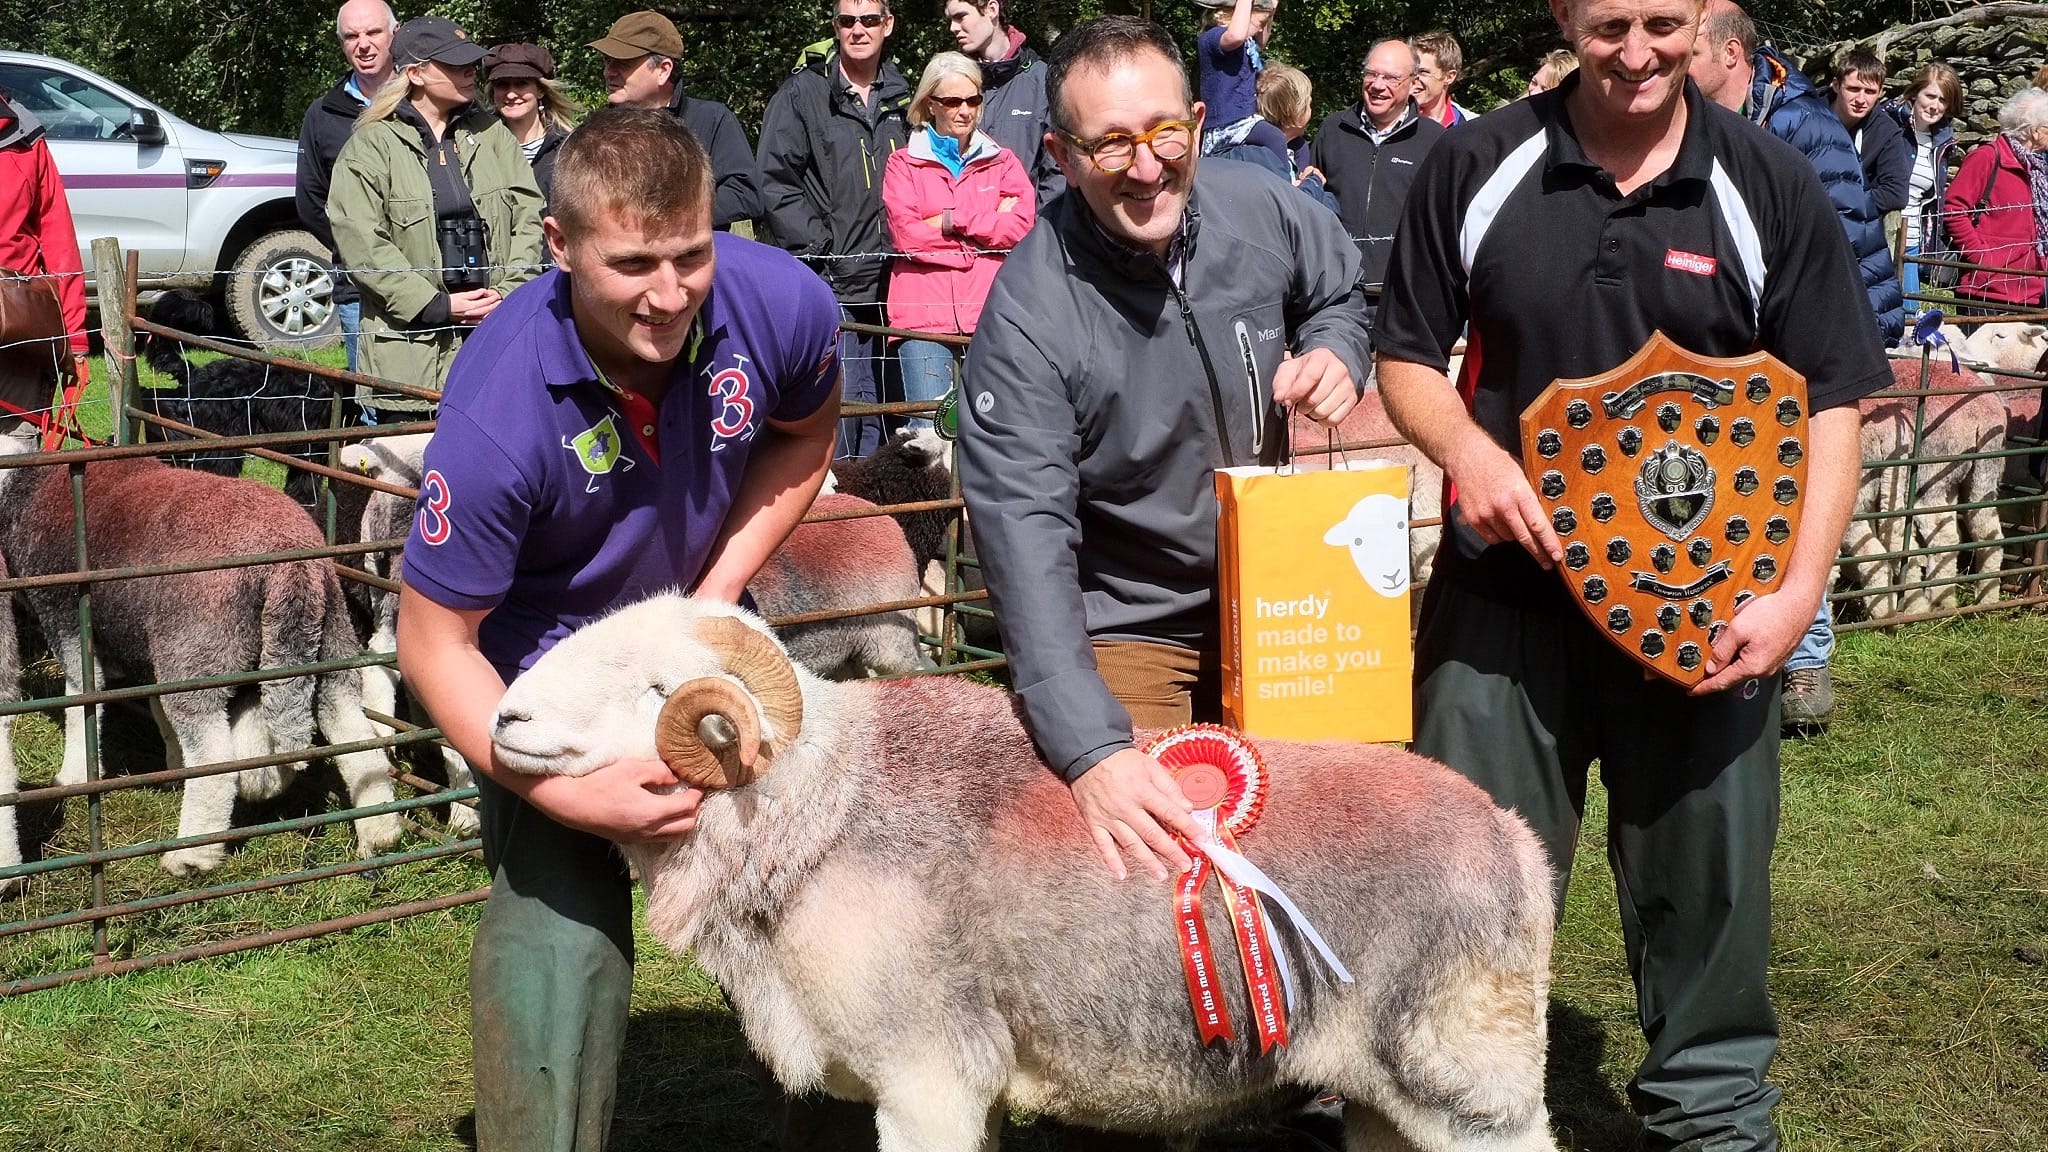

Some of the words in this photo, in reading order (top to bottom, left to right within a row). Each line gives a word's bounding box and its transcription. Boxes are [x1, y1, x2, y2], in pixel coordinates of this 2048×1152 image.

[1667, 253, 1714, 273] Heiniger
[709, 368, 755, 438] 3
[419, 470, 452, 547] 3
[1256, 594, 1329, 620] herdy
[1257, 623, 1328, 648] made
[1335, 622, 1361, 643] to
[1258, 650, 1328, 673] make
[1335, 649, 1381, 674] you
[1259, 674, 1334, 699] smile!
[1185, 918, 1200, 946] land
[1242, 909, 1265, 978] weather-fed
[1202, 990, 1215, 1011] this
[1258, 983, 1277, 1034] hill-bred
[1208, 1012, 1219, 1025] in
